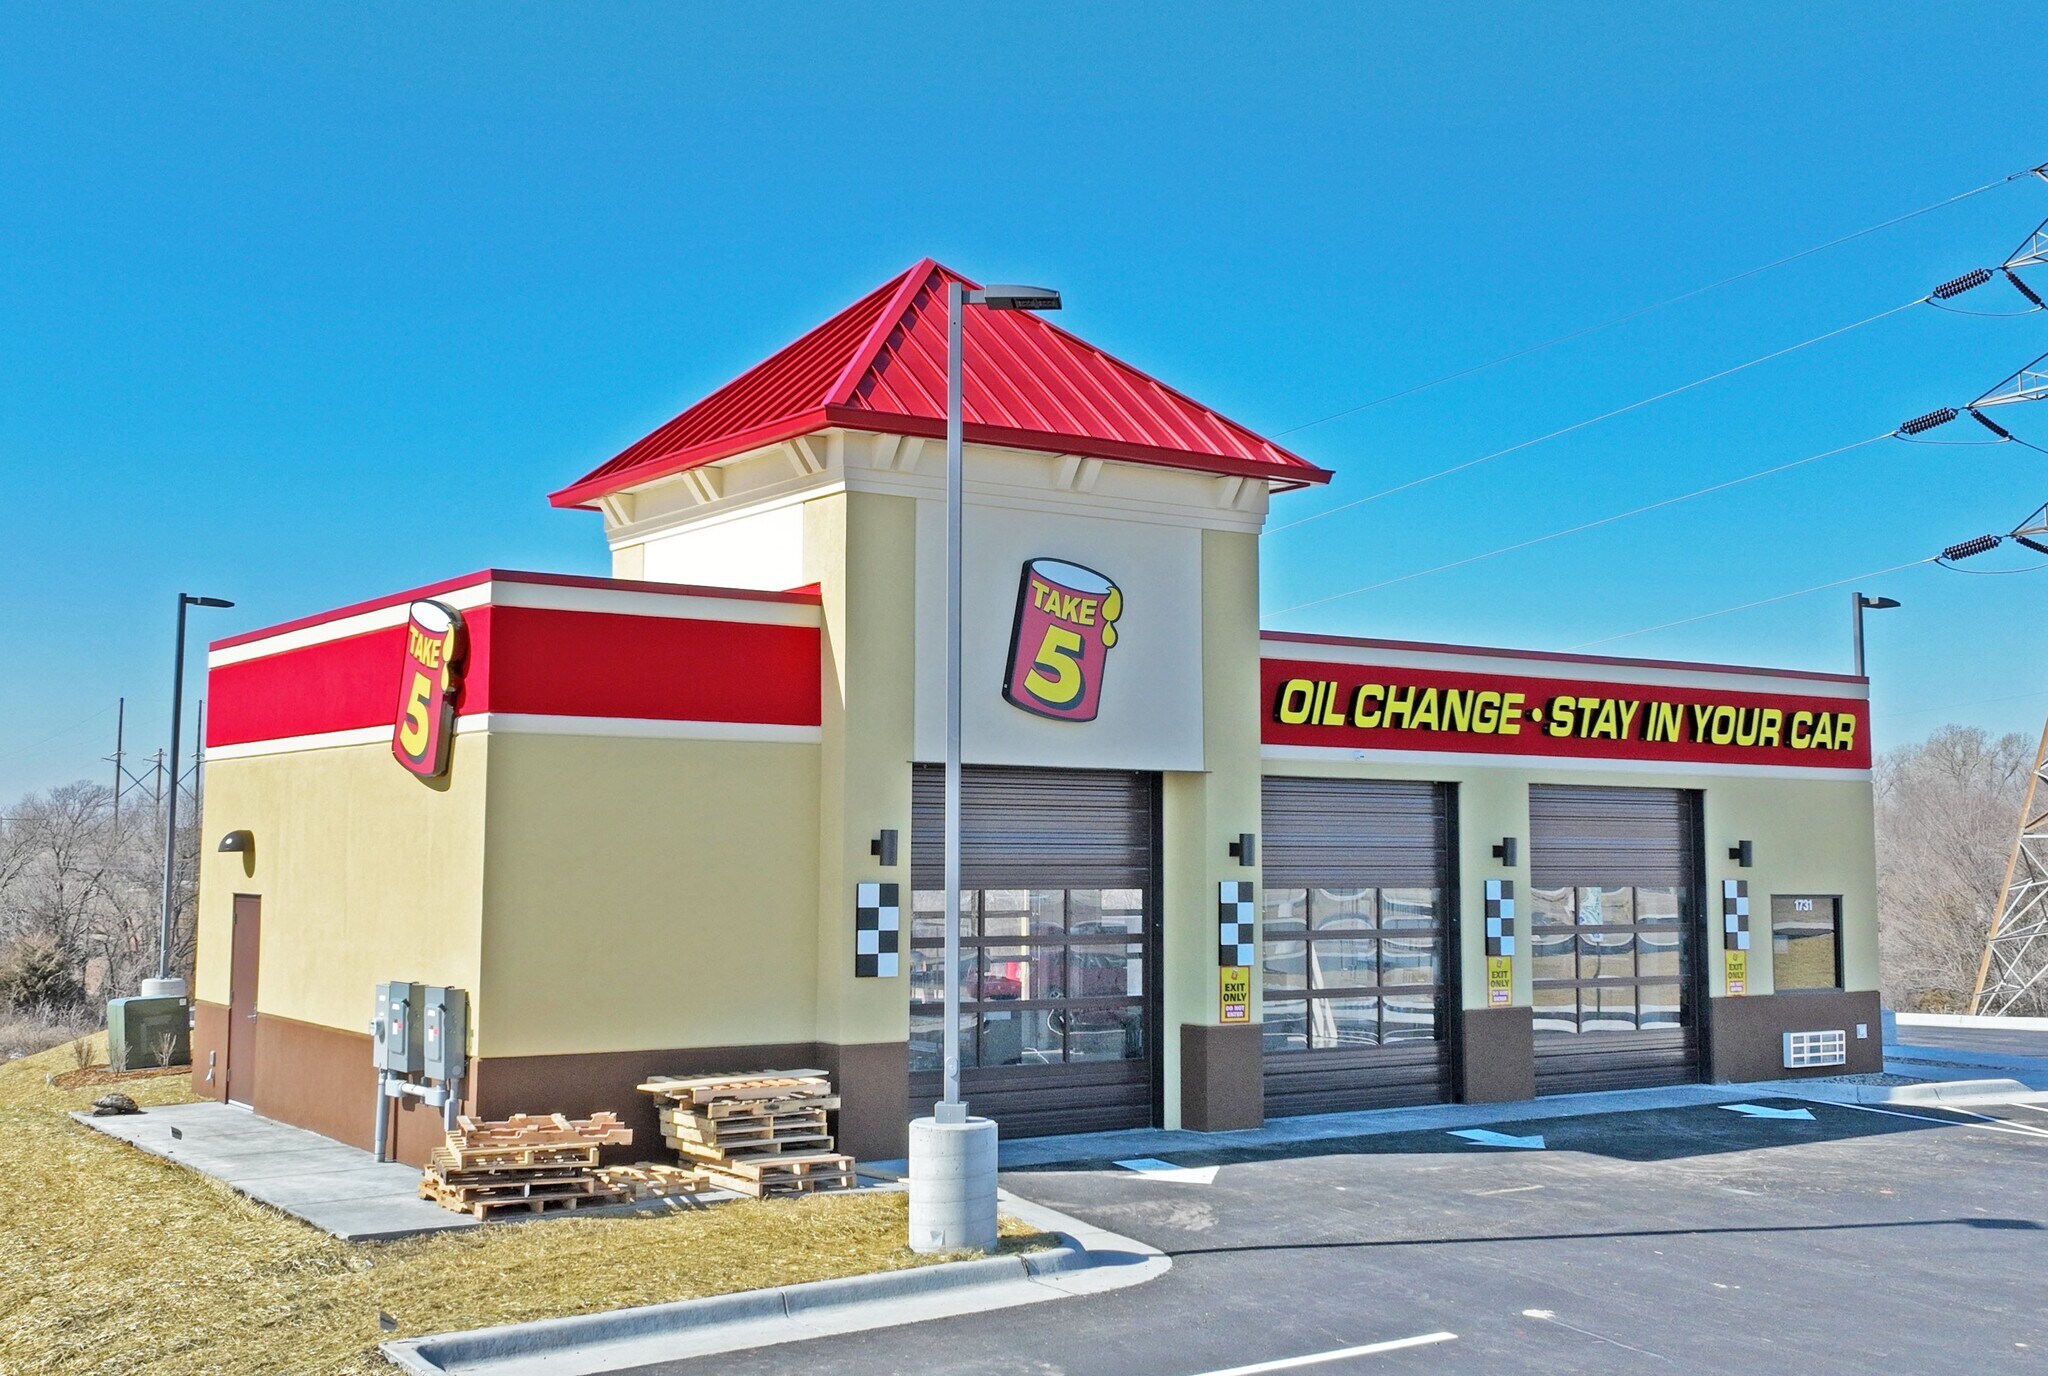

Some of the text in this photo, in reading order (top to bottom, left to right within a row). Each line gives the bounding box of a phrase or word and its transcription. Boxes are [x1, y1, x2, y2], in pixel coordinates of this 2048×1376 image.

[1032, 580, 1098, 625] TAKE
[409, 624, 441, 669] TAKE
[1023, 624, 1083, 707] 5
[400, 671, 432, 760] 5
[1279, 678, 1856, 751] OIL CHANGE STAY IN YOUR CAR
[1794, 899, 1813, 911] 1731
[1225, 983, 1245, 991] EXIT
[1491, 970, 1508, 978] EXIT
[1223, 993, 1247, 1002] ONLY
